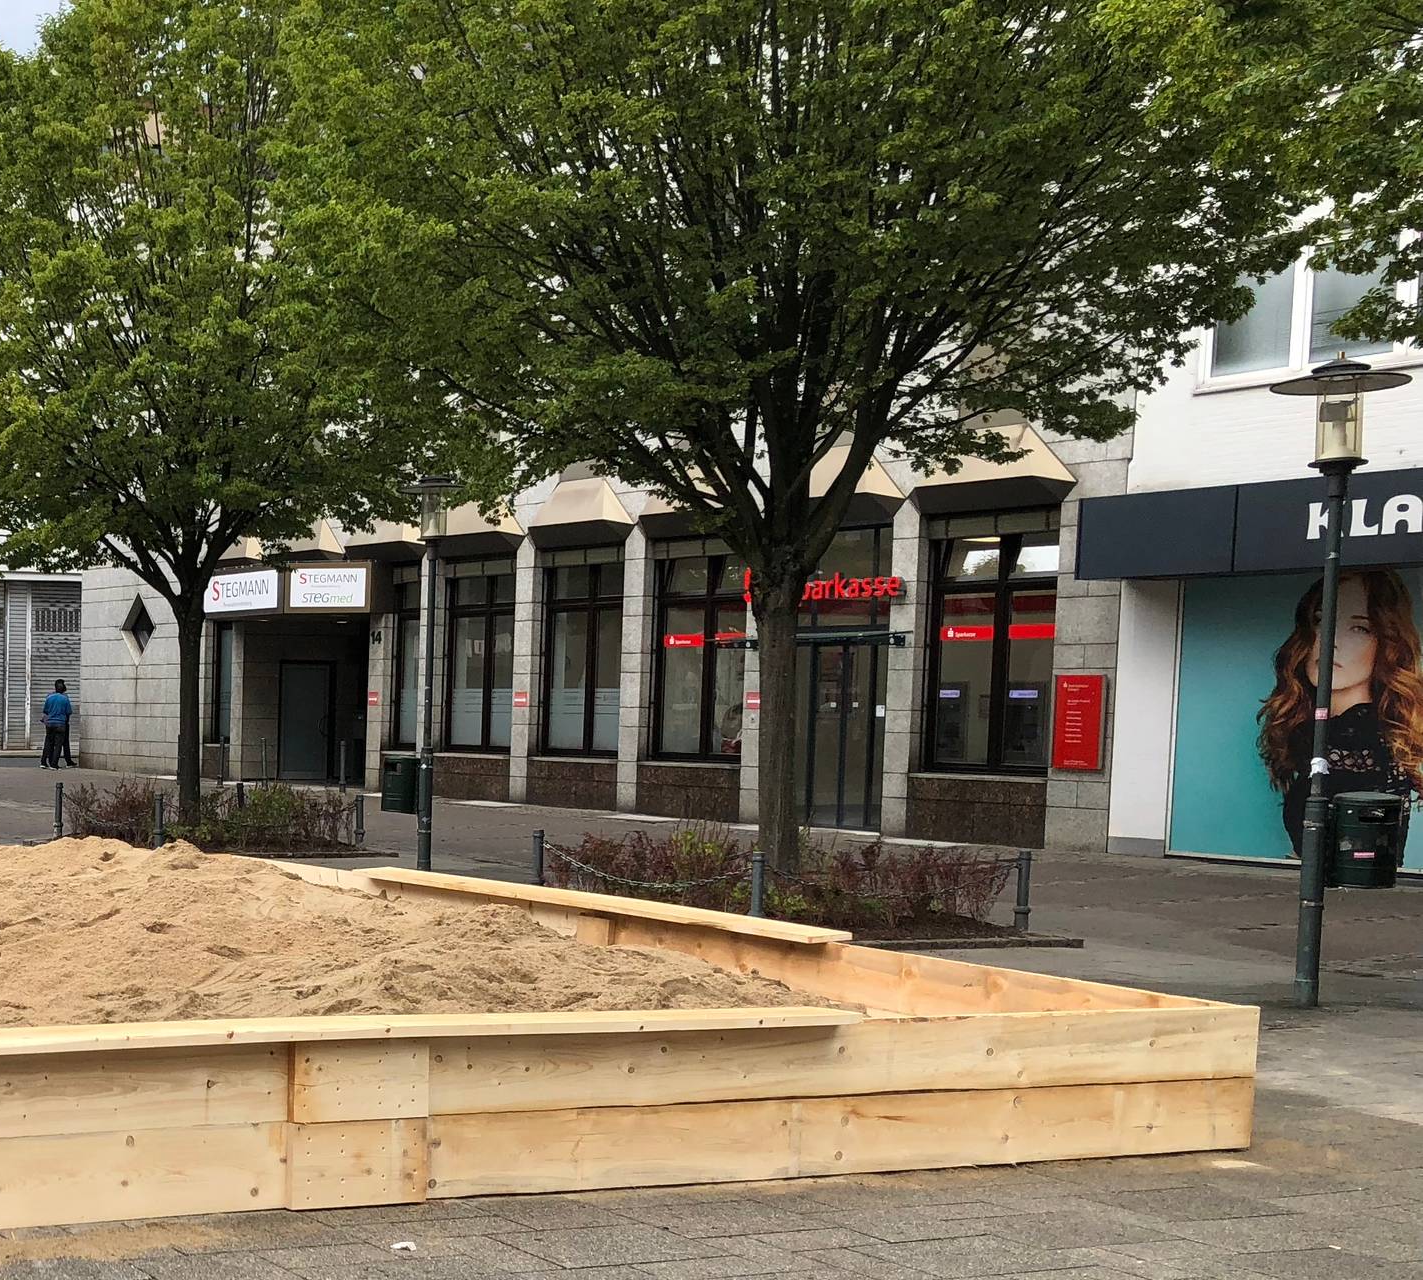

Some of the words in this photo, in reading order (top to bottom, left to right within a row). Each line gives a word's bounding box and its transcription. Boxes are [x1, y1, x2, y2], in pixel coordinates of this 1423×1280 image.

[299, 573, 357, 584] STEGMANN
[212, 579, 269, 601] STEGMANN
[799, 571, 902, 606] arkasse
[370, 631, 382, 645] 14
